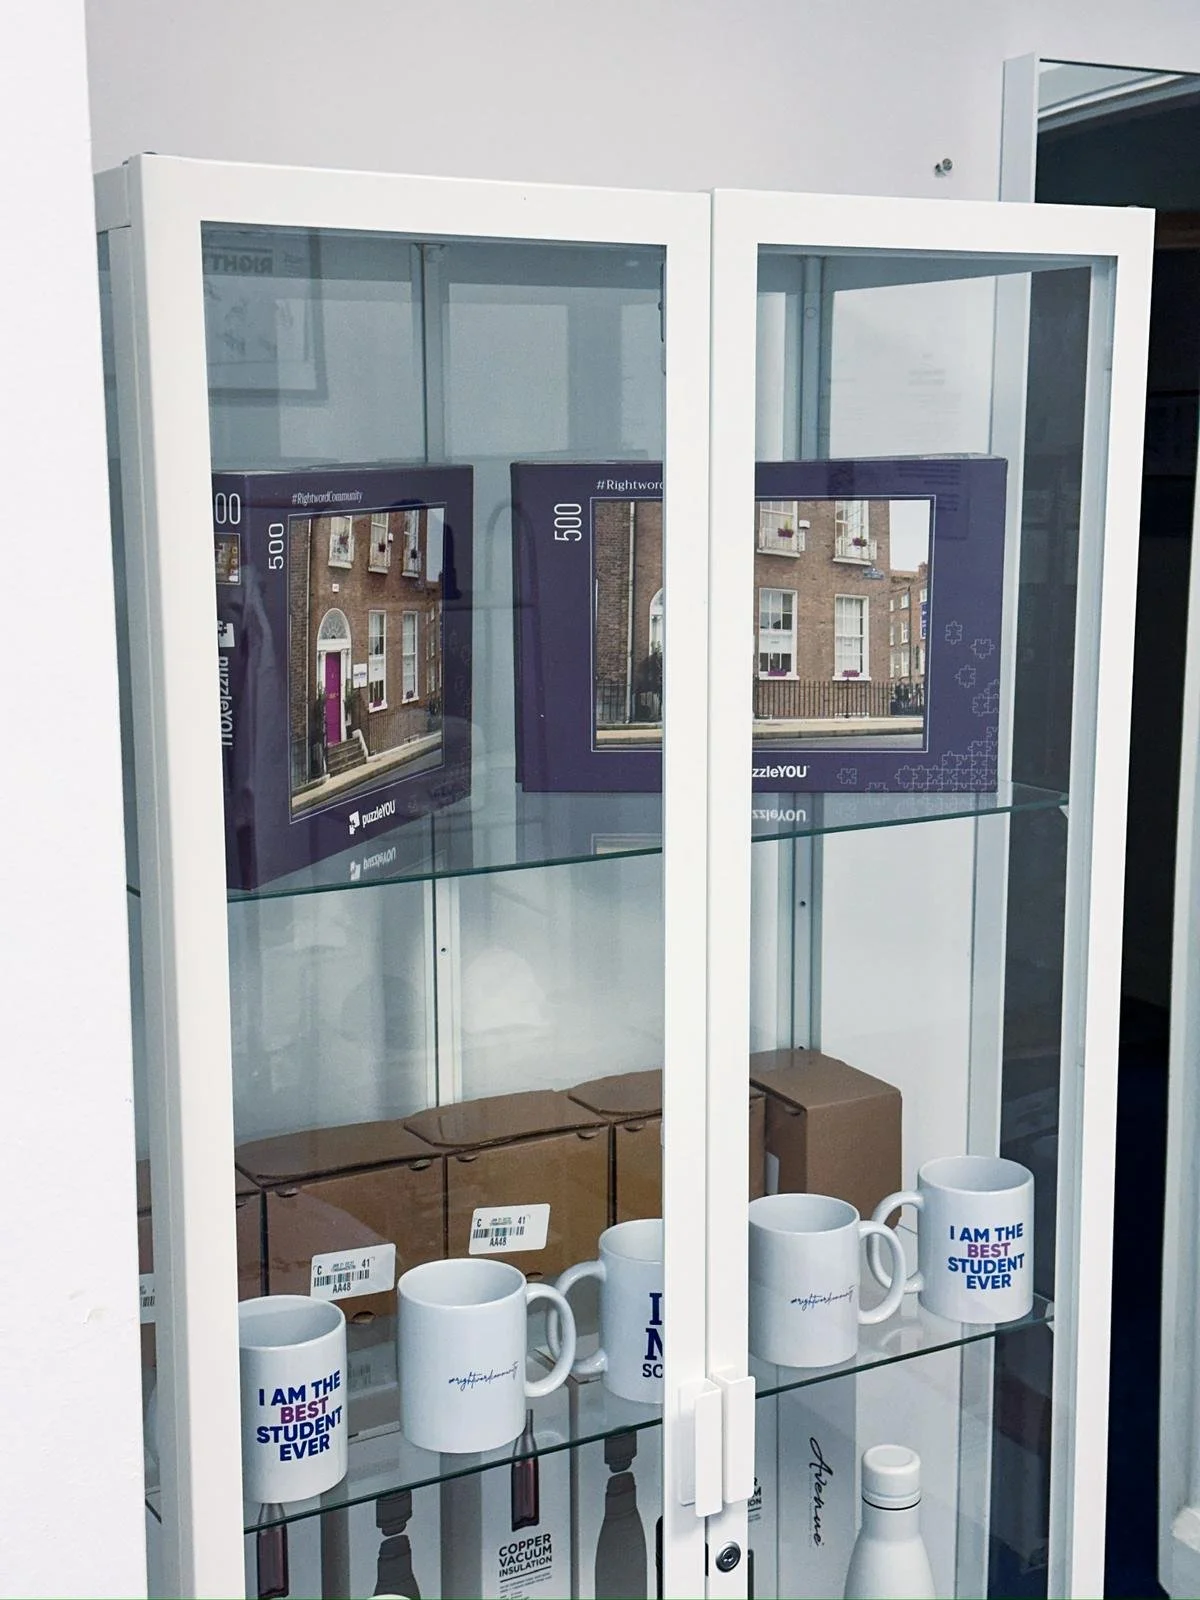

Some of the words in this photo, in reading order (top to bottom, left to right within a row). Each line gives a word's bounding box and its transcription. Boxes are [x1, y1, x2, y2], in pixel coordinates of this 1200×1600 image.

[292, 490, 362, 506] #RightwordCommunity
[554, 503, 582, 541] 500
[268, 522, 285, 570] 500
[362, 800, 396, 828] puzzleYOU
[949, 1225, 955, 1240] I
[959, 1227, 990, 1243] AM
[994, 1222, 1024, 1242] THE
[967, 1242, 1011, 1258] BEST
[361, 1258, 370, 1268] 41
[947, 1253, 1025, 1274] STUDENT
[332, 1282, 351, 1294] AA48
[966, 1273, 1012, 1290] EVER
[259, 1388, 265, 1406] I
[271, 1384, 306, 1406] AM
[311, 1369, 341, 1399] THE
[280, 1396, 329, 1424] BEST
[256, 1405, 343, 1444] STUDENT
[280, 1433, 330, 1461] EVER
[498, 1533, 552, 1557] COPPER
[498, 1543, 552, 1567] VACUUM
[498, 1555, 552, 1577] INSULATION
